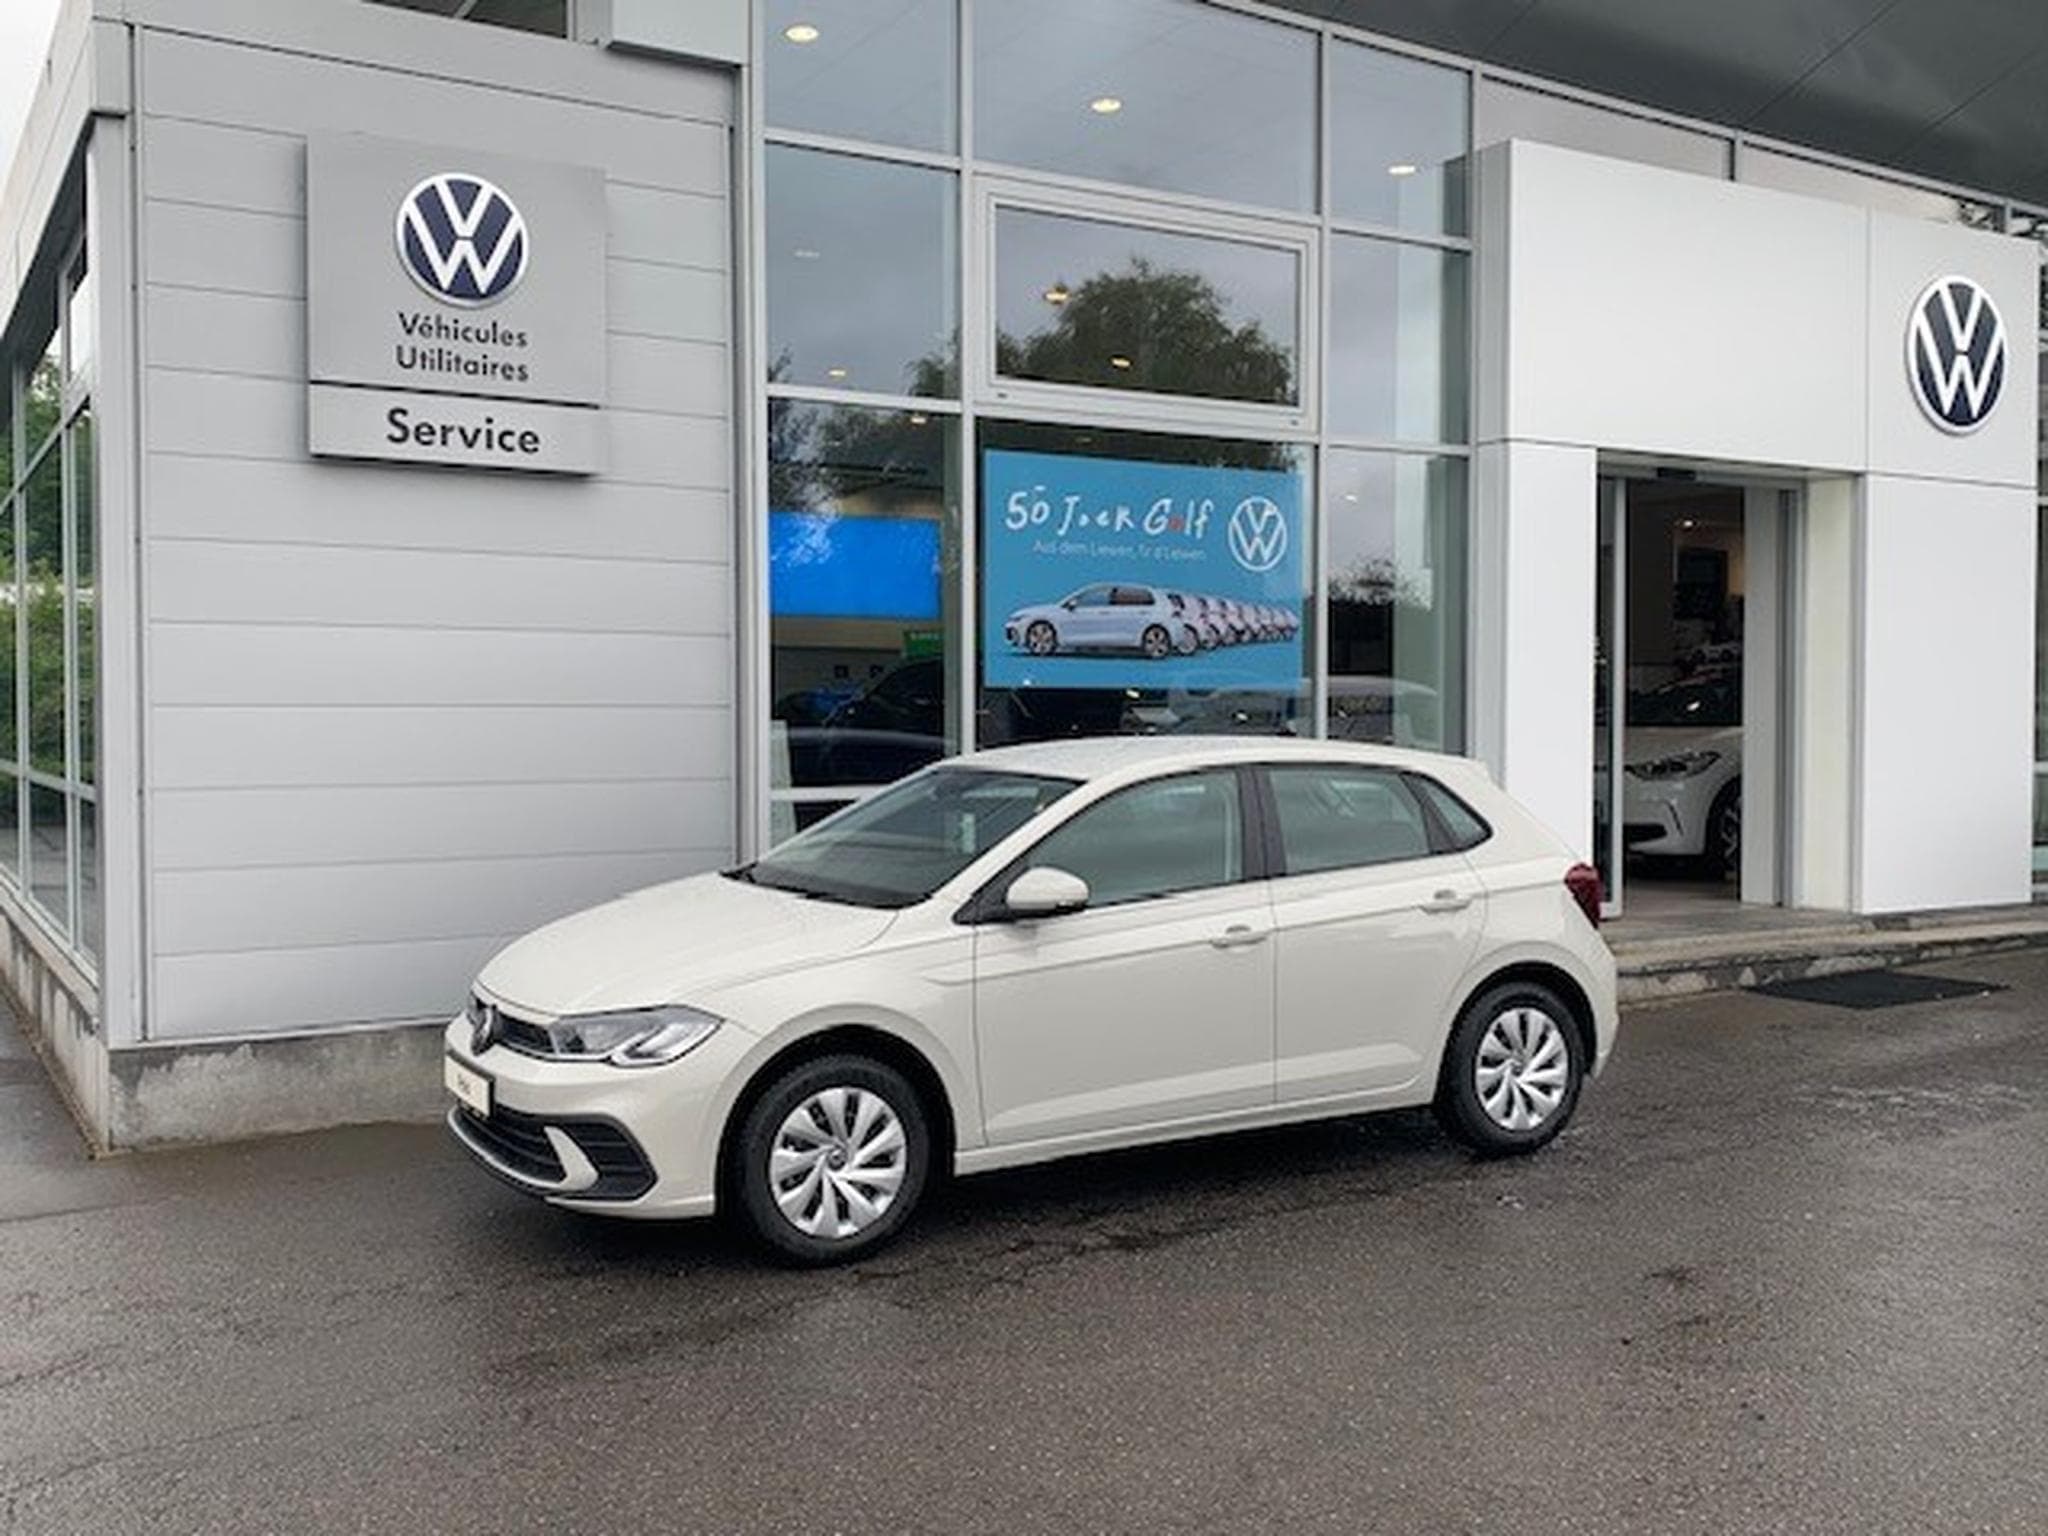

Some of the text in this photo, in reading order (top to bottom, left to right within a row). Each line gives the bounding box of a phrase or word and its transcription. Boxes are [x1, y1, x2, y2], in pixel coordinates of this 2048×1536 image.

[400, 175, 525, 300] VW
[399, 311, 528, 348] Véhicules
[1912, 277, 2006, 424] VW
[397, 344, 529, 382] Utilitaires
[386, 407, 540, 454] Service
[1006, 486, 1050, 530] 50
[1143, 498, 1214, 539] Golf
[1228, 496, 1287, 571] VW
